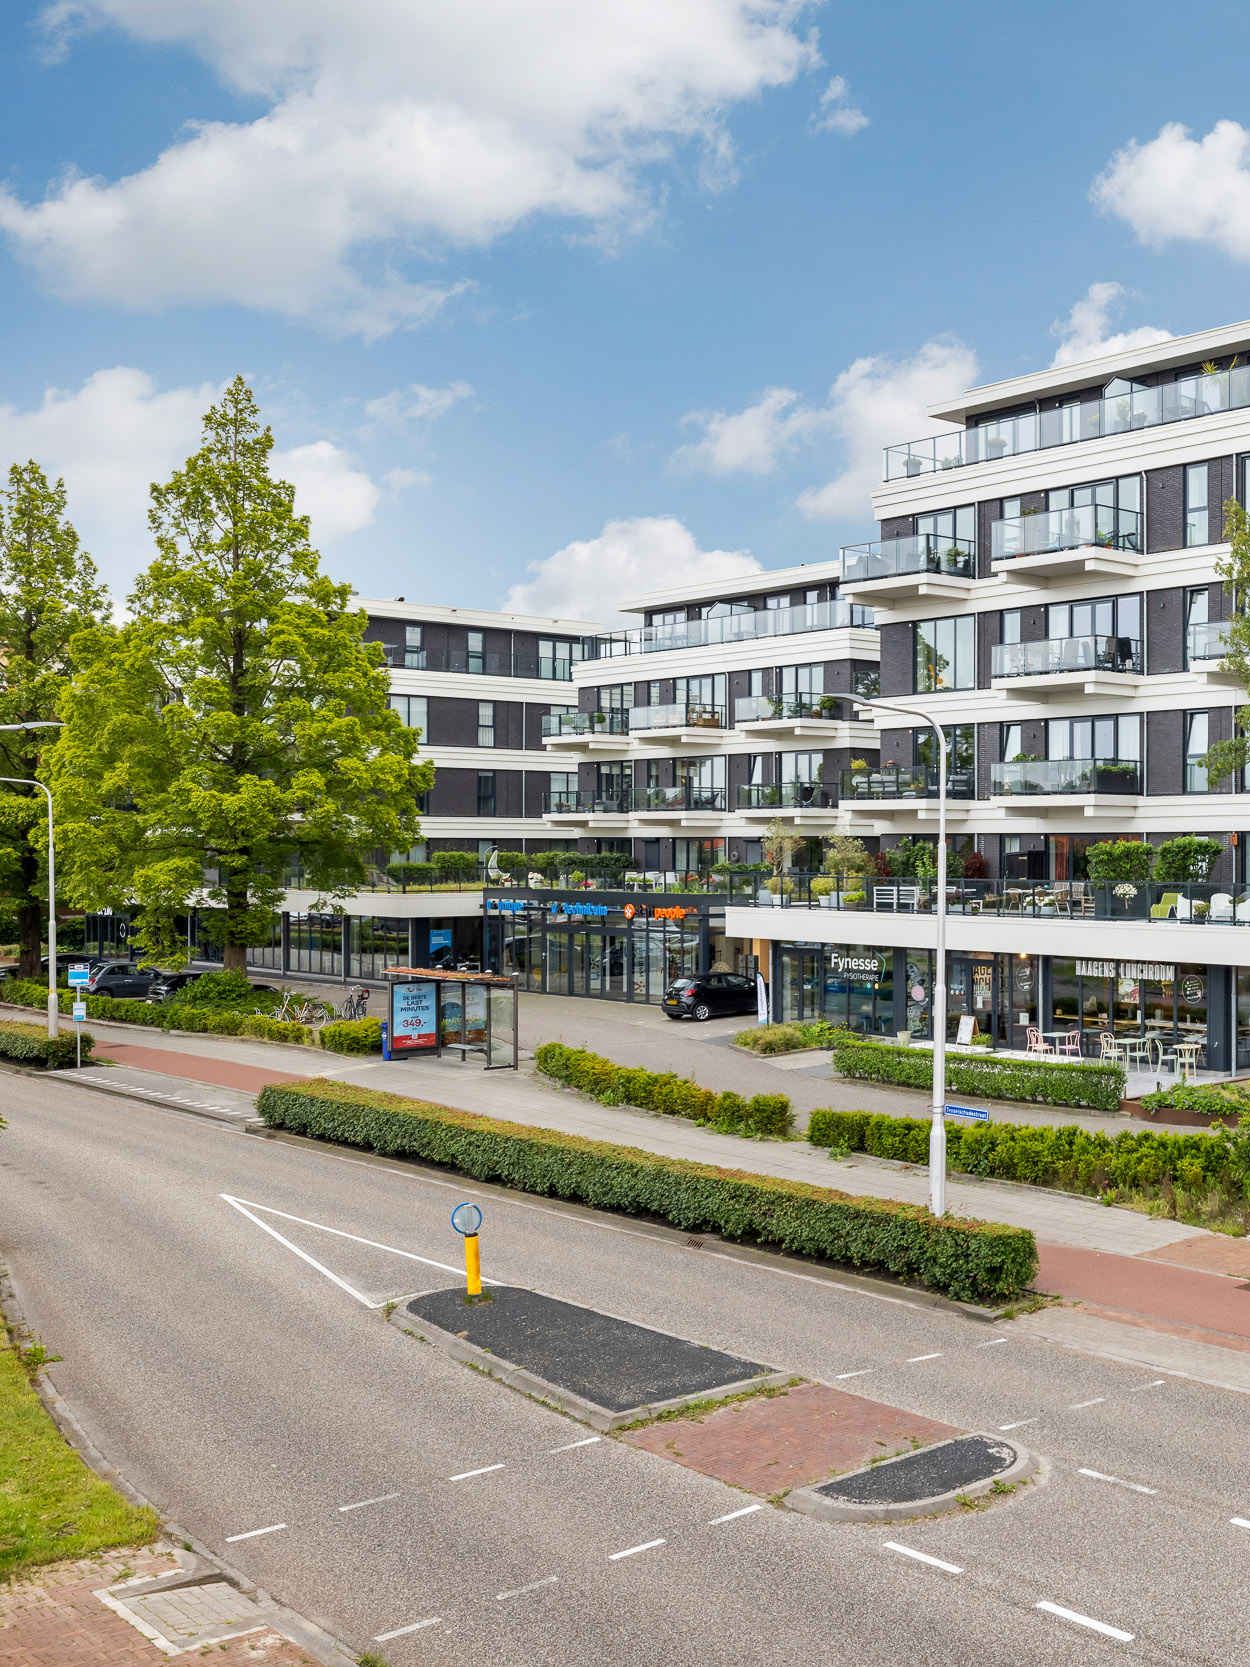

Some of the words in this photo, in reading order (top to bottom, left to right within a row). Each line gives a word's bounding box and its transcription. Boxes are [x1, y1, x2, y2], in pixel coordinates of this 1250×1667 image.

[831, 953, 878, 972] Fynesse
[1075, 960, 1115, 978] HAAGENS
[1120, 962, 1175, 981] LUNCHROOM
[402, 1019, 427, 1028] 349,-
